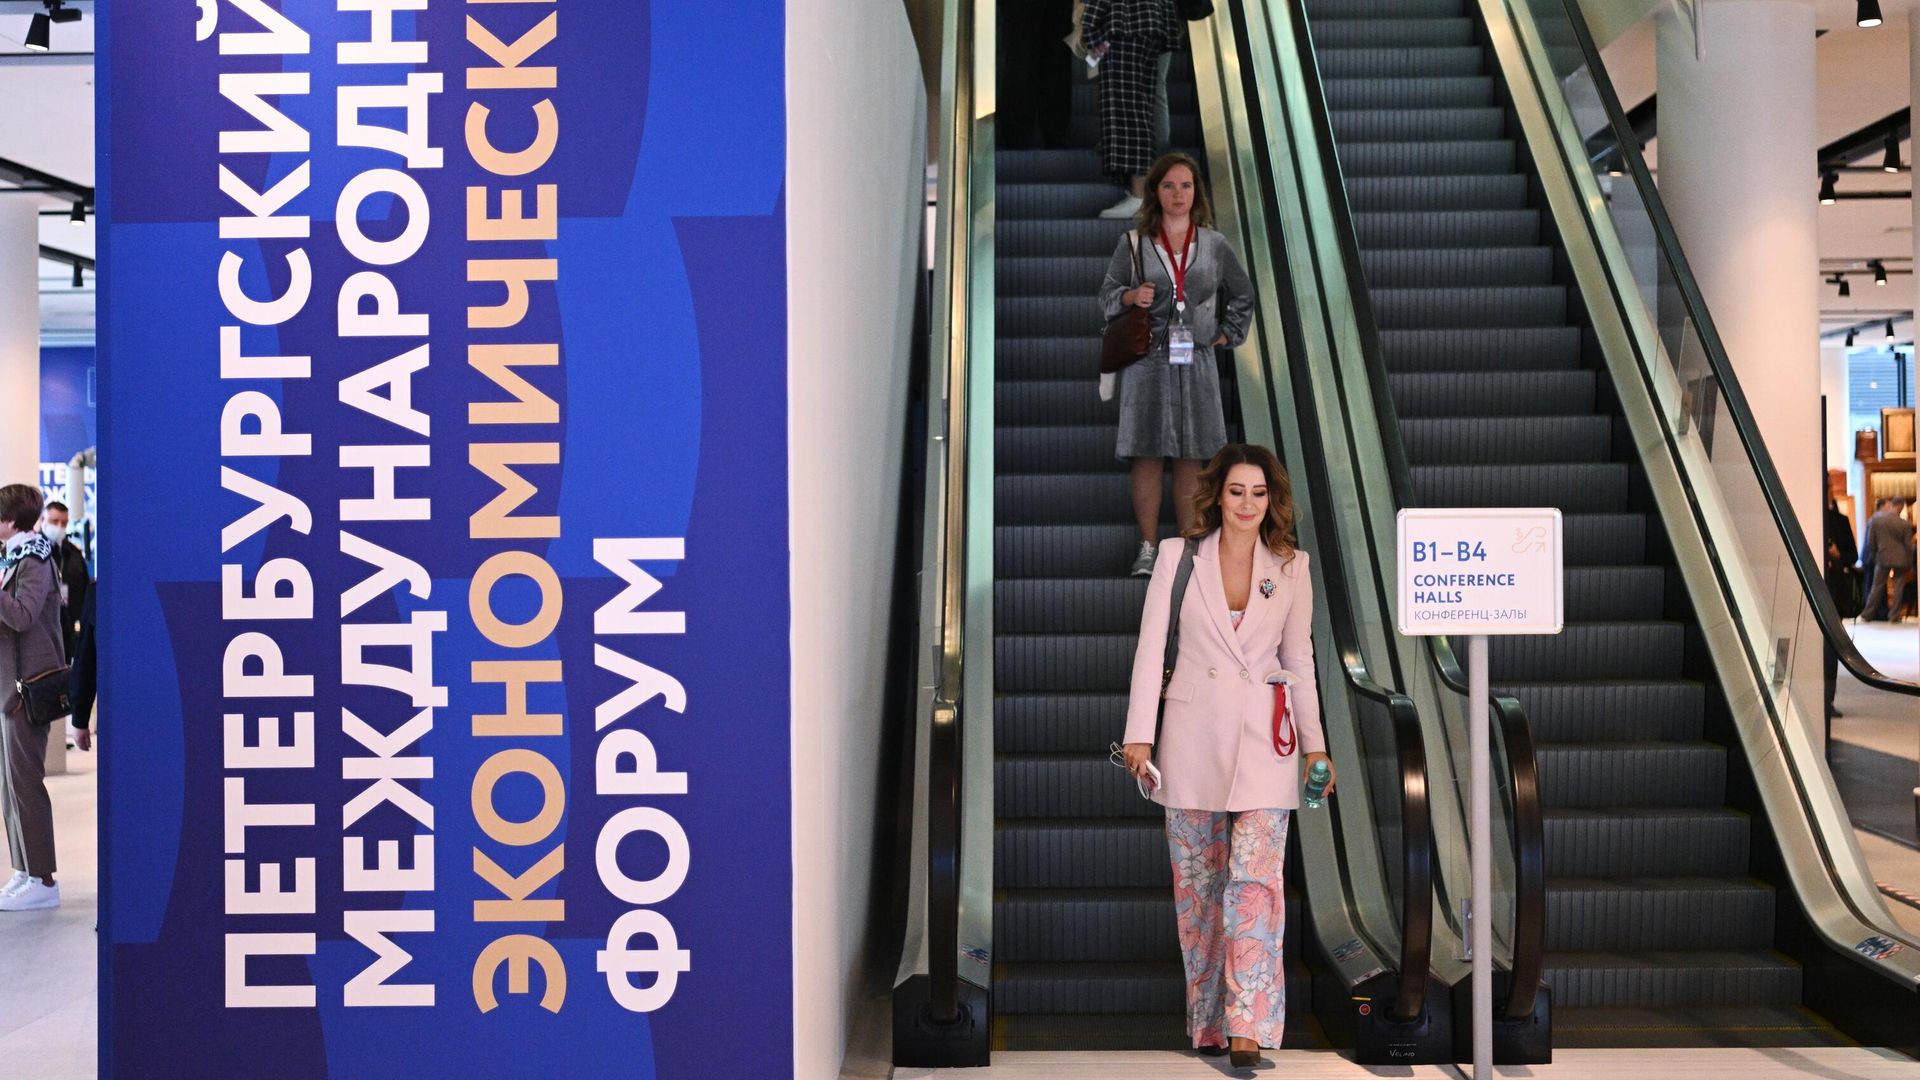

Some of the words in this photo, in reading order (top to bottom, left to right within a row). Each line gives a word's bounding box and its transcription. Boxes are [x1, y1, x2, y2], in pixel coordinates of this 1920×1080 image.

[196, 0, 316, 1008] ПЕТЕРБУРГСКИЙ
[336, 0, 448, 1007] МЕЖДУНАРОДН
[464, 0, 567, 1014] ЭКОНОМИЧЕСК
[1413, 574, 1515, 587] CONFERENCE
[1414, 591, 1463, 603] HALLS
[1414, 609, 1527, 621] КОНФЕРЕНЦ-ЗАЛЫ
[593, 537, 690, 1013] ФОРУМ
